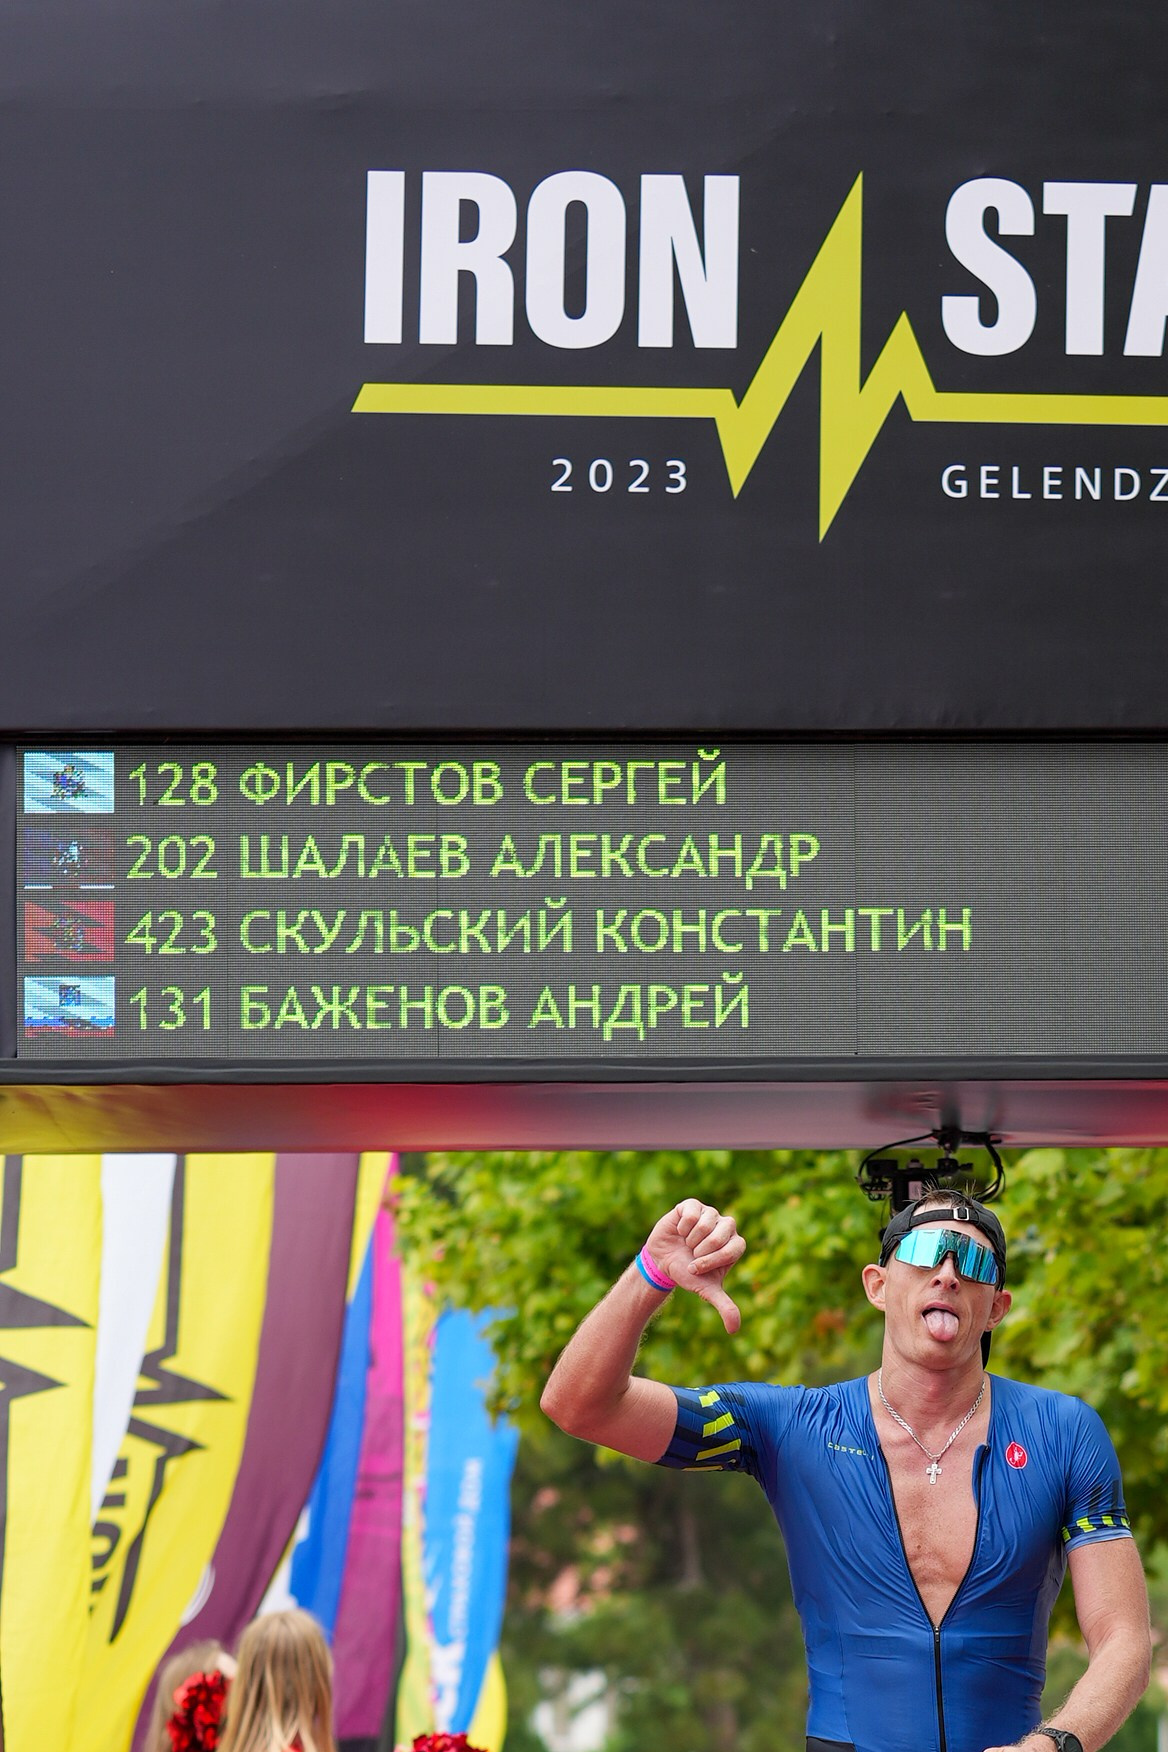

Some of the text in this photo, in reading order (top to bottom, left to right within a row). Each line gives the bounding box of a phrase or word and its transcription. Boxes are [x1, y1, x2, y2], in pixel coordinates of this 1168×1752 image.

[363, 170, 740, 349] IRON
[551, 458, 688, 494] 2023
[128, 749, 727, 805] 128 ФИРСТОВ СЕРГЕЙ
[126, 832, 821, 890] 202 ШАЛАЕВ АЛЕКСАНДР
[125, 898, 973, 954] 423 СКУЛЬСКИЙ КОНСТАНТИН
[129, 971, 750, 1041] 131 БАЖЕНОВ АНДРЕЙ
